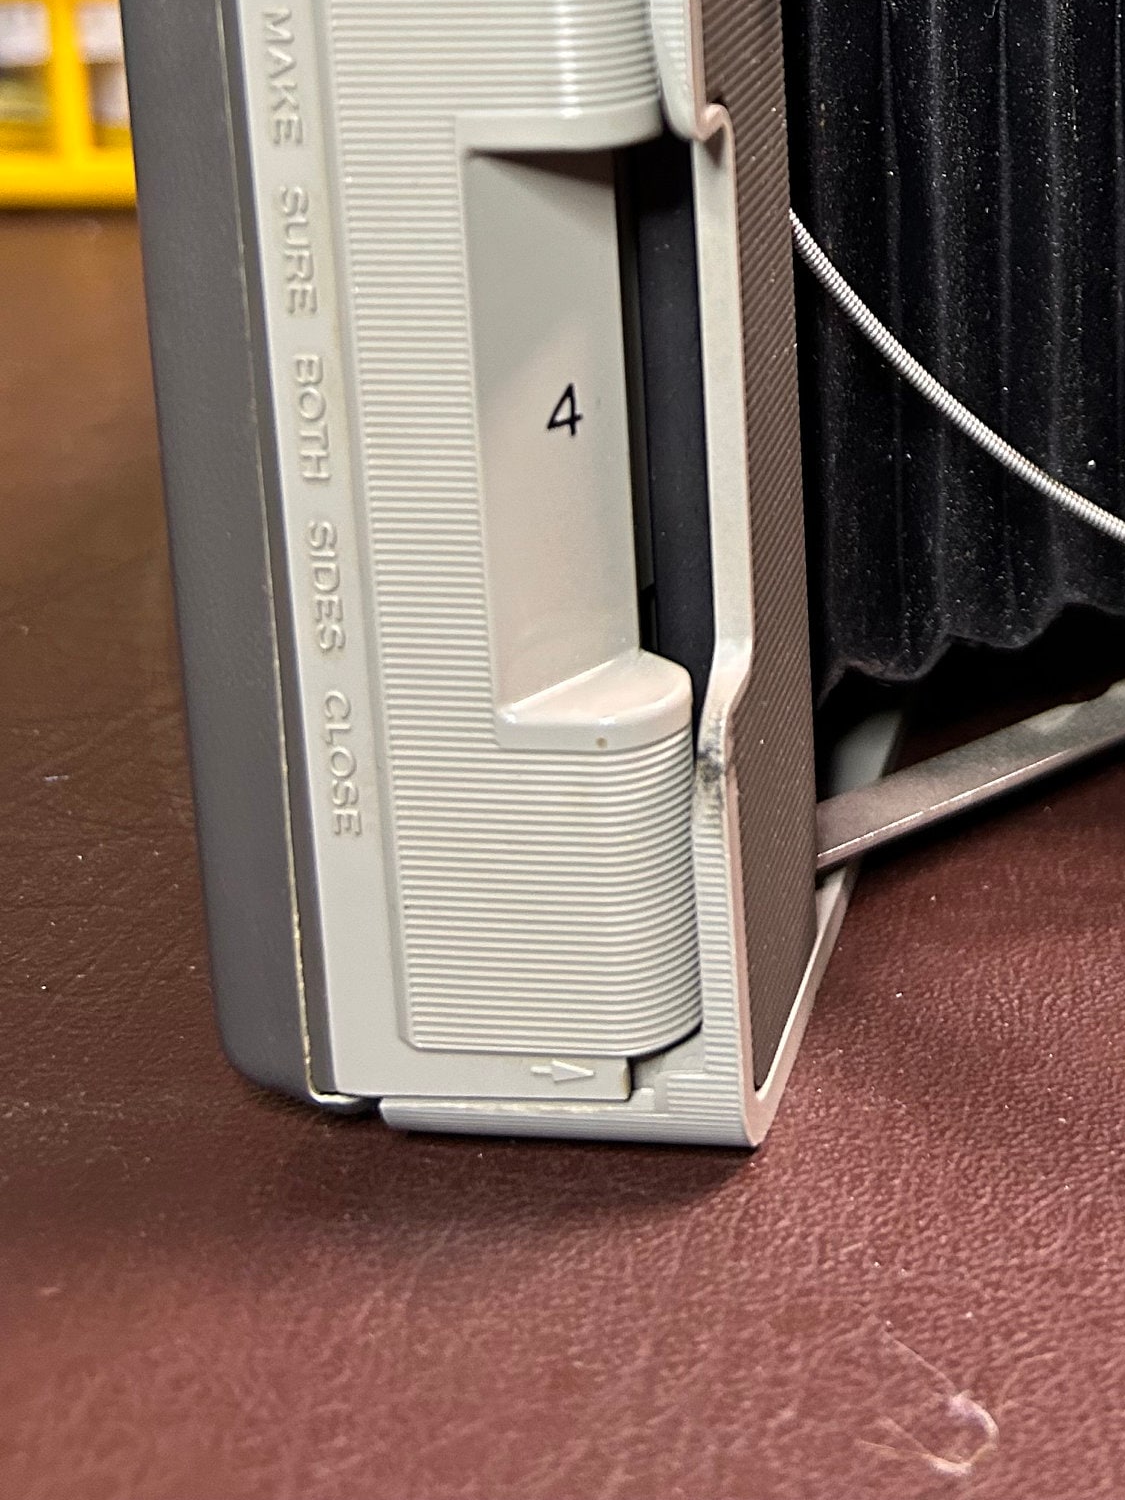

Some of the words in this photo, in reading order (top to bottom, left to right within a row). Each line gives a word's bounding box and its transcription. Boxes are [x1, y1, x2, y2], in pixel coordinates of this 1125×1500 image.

[261, 7, 304, 146] MAKE
[279, 185, 319, 316] SURE
[295, 354, 332, 485] BOTH
[546, 382, 584, 437] 4
[307, 520, 347, 653] SIDES
[324, 688, 362, 836] CLOSE
